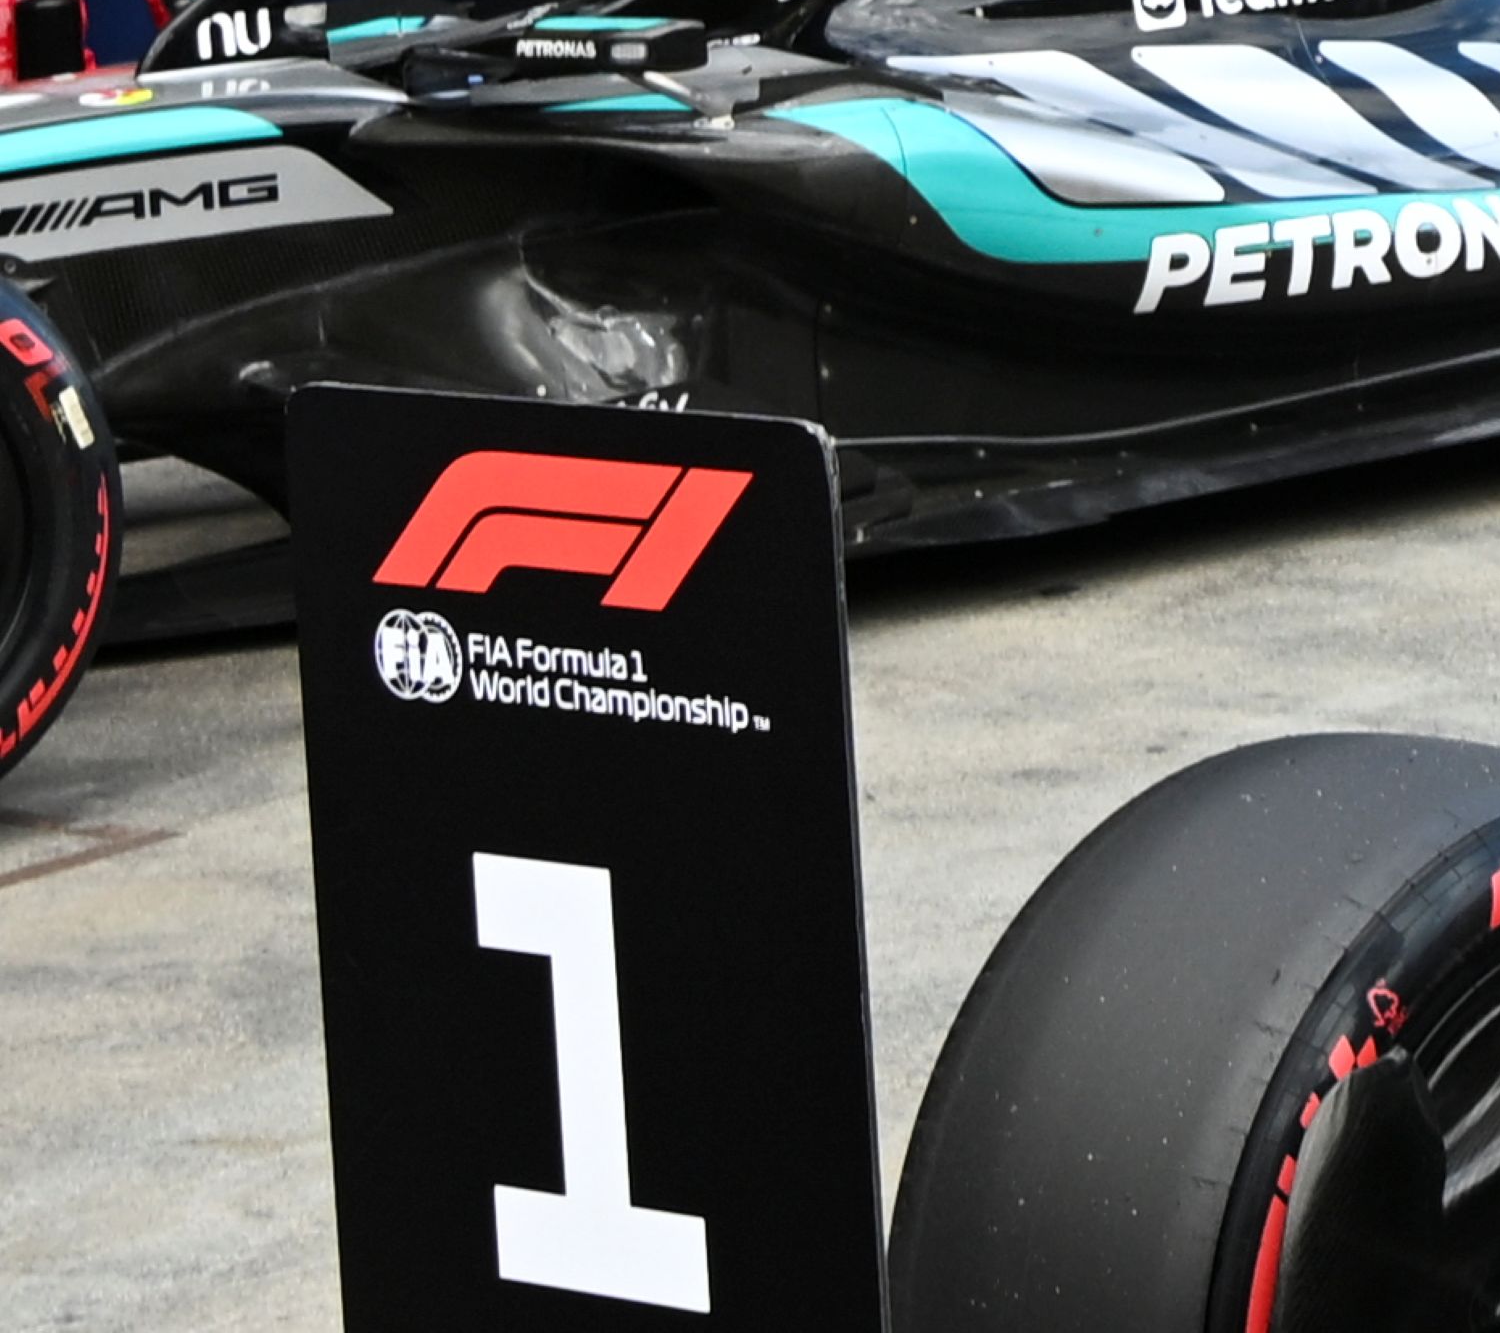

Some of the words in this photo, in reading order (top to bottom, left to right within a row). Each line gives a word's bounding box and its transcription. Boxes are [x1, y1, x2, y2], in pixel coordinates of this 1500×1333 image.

[516, 39, 597, 60] PETRONAS
[80, 172, 280, 221] AMG
[371, 449, 754, 612] F1
[378, 626, 456, 685] FIA
[468, 631, 510, 666] FIA
[514, 635, 625, 681] Formula
[630, 650, 648, 683] 1
[468, 668, 551, 707] World
[554, 677, 750, 733] Championship
[471, 850, 711, 1314] 1
